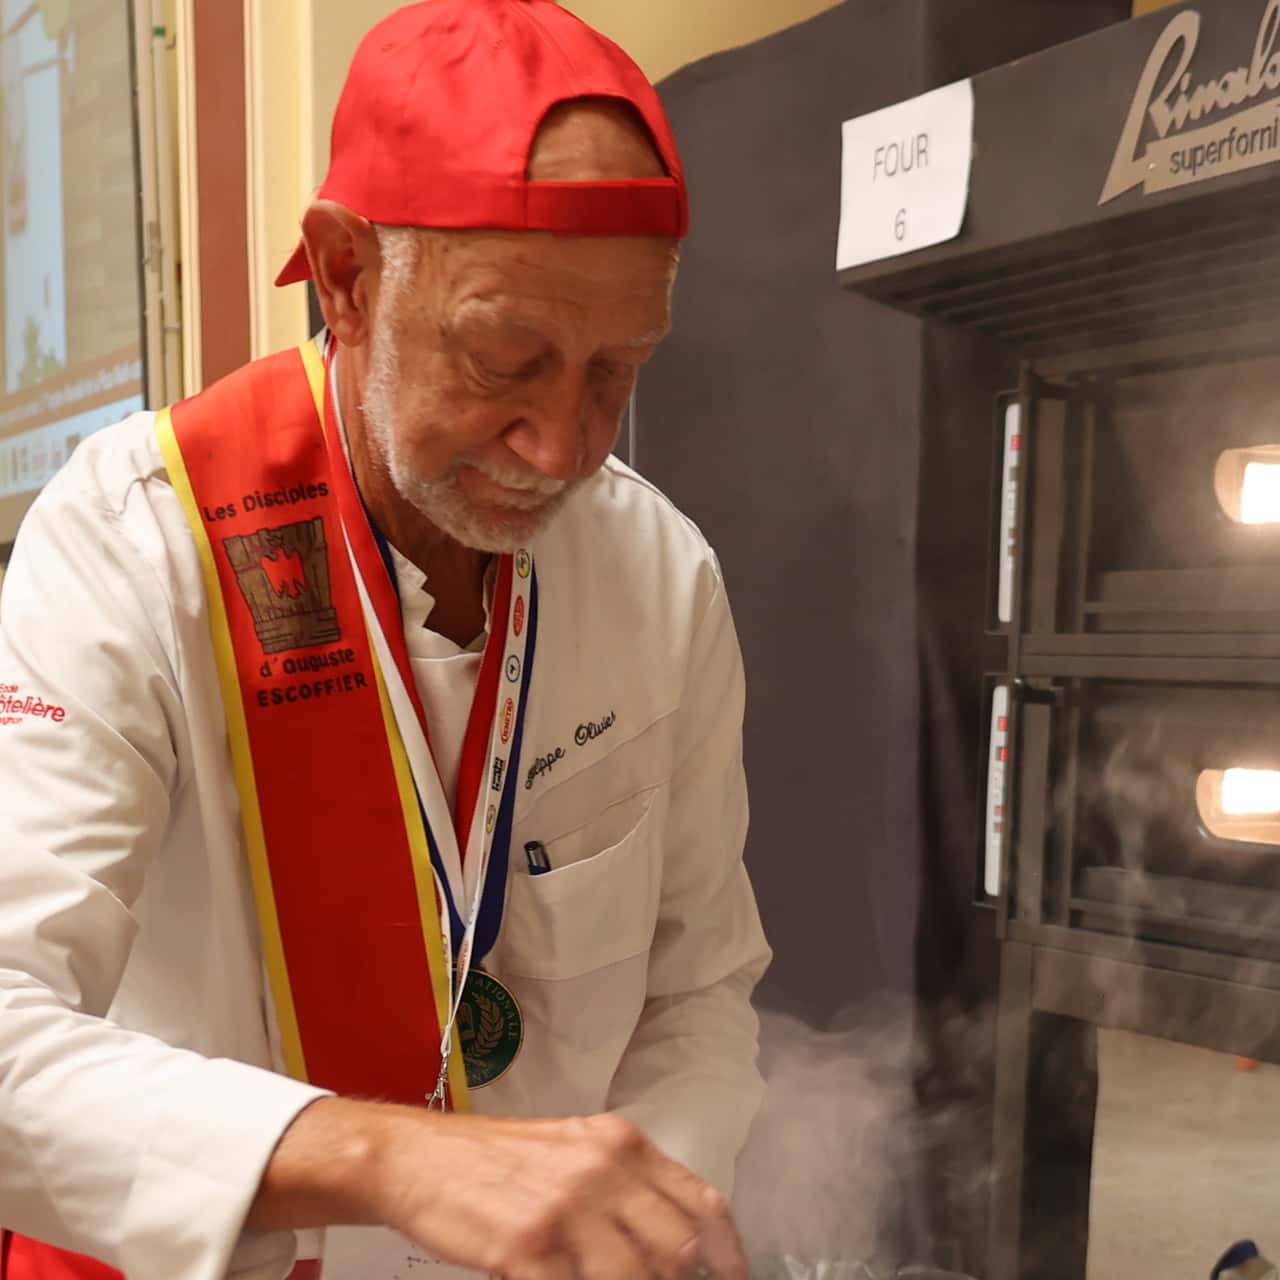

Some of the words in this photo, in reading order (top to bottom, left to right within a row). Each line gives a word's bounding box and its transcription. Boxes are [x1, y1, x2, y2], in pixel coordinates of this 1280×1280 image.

[872, 133, 929, 182] FOUR
[1169, 116, 1279, 176] superforni
[895, 208, 907, 241] 6
[203, 503, 237, 523] Les
[243, 482, 329, 513] Disciples
[257, 672, 368, 708] ESCOFFIER
[574, 711, 616, 746] Olivier
